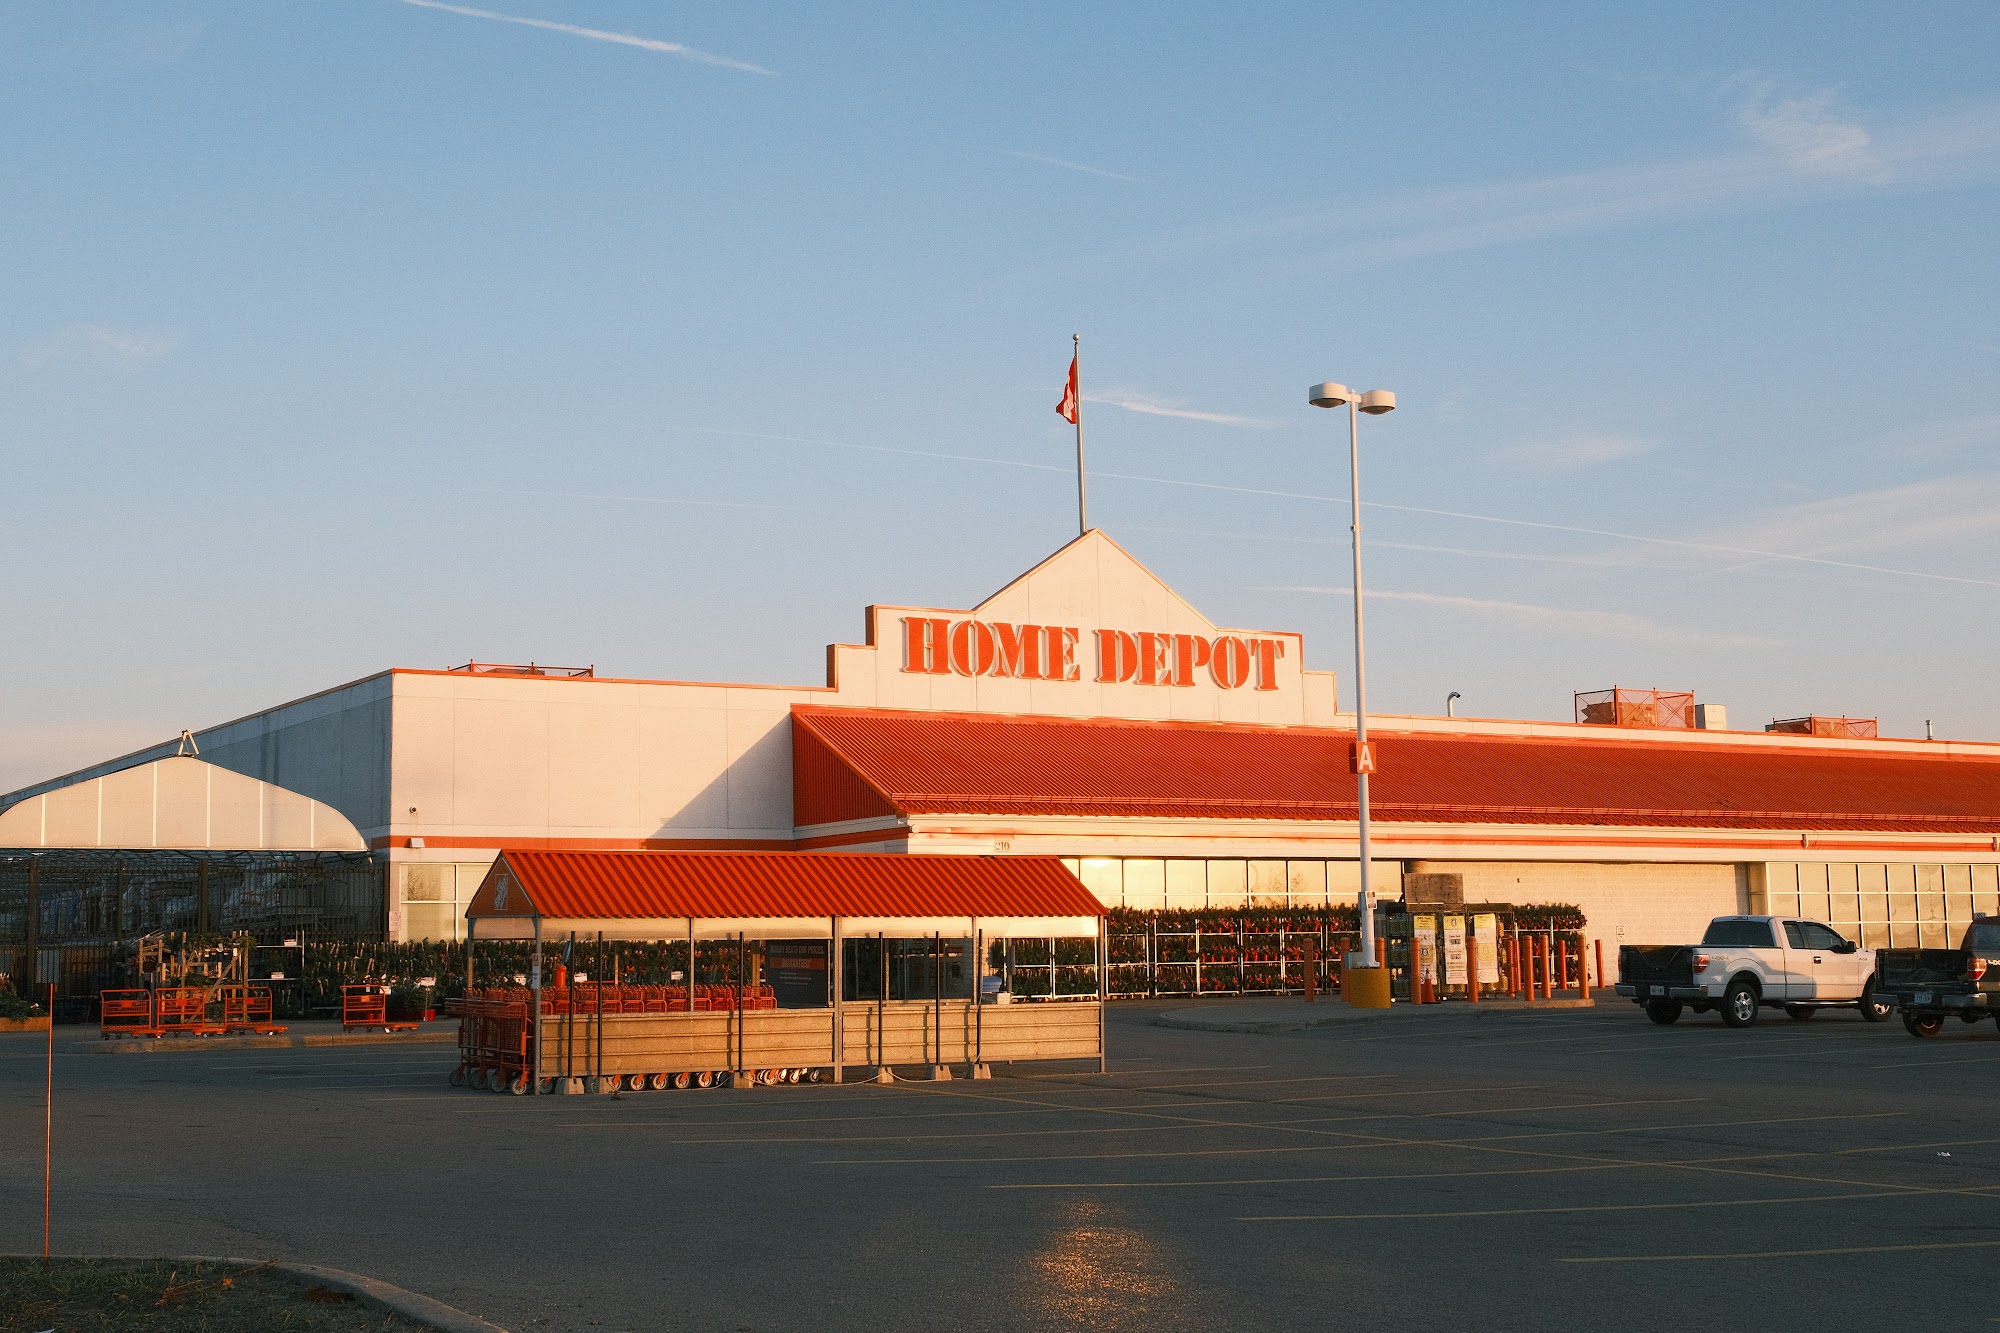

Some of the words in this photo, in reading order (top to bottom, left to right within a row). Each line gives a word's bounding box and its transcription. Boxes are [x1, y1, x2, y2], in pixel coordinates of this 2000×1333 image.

[900, 616, 1080, 682] HOME
[1093, 629, 1285, 691] DEPOT
[1358, 744, 1374, 771] A
[995, 841, 1010, 851] 210
